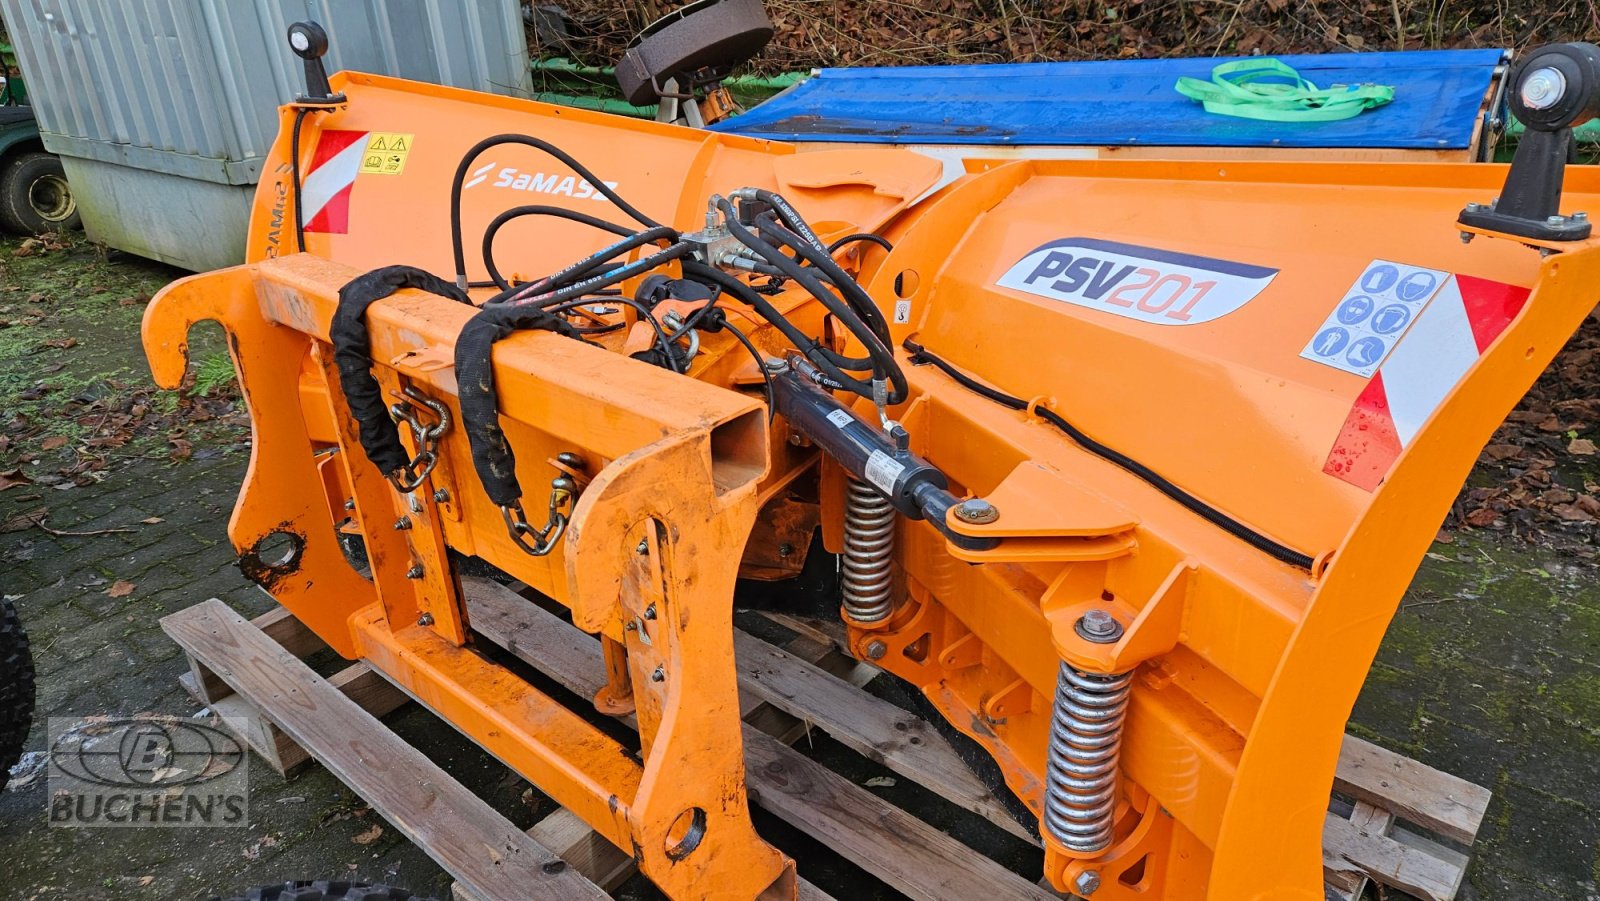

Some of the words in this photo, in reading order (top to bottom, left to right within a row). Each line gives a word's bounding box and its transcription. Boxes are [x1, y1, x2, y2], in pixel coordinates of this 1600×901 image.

[557, 286, 572, 295] DIN
[574, 281, 587, 289] EN
[1024, 250, 1218, 322] PSV201
